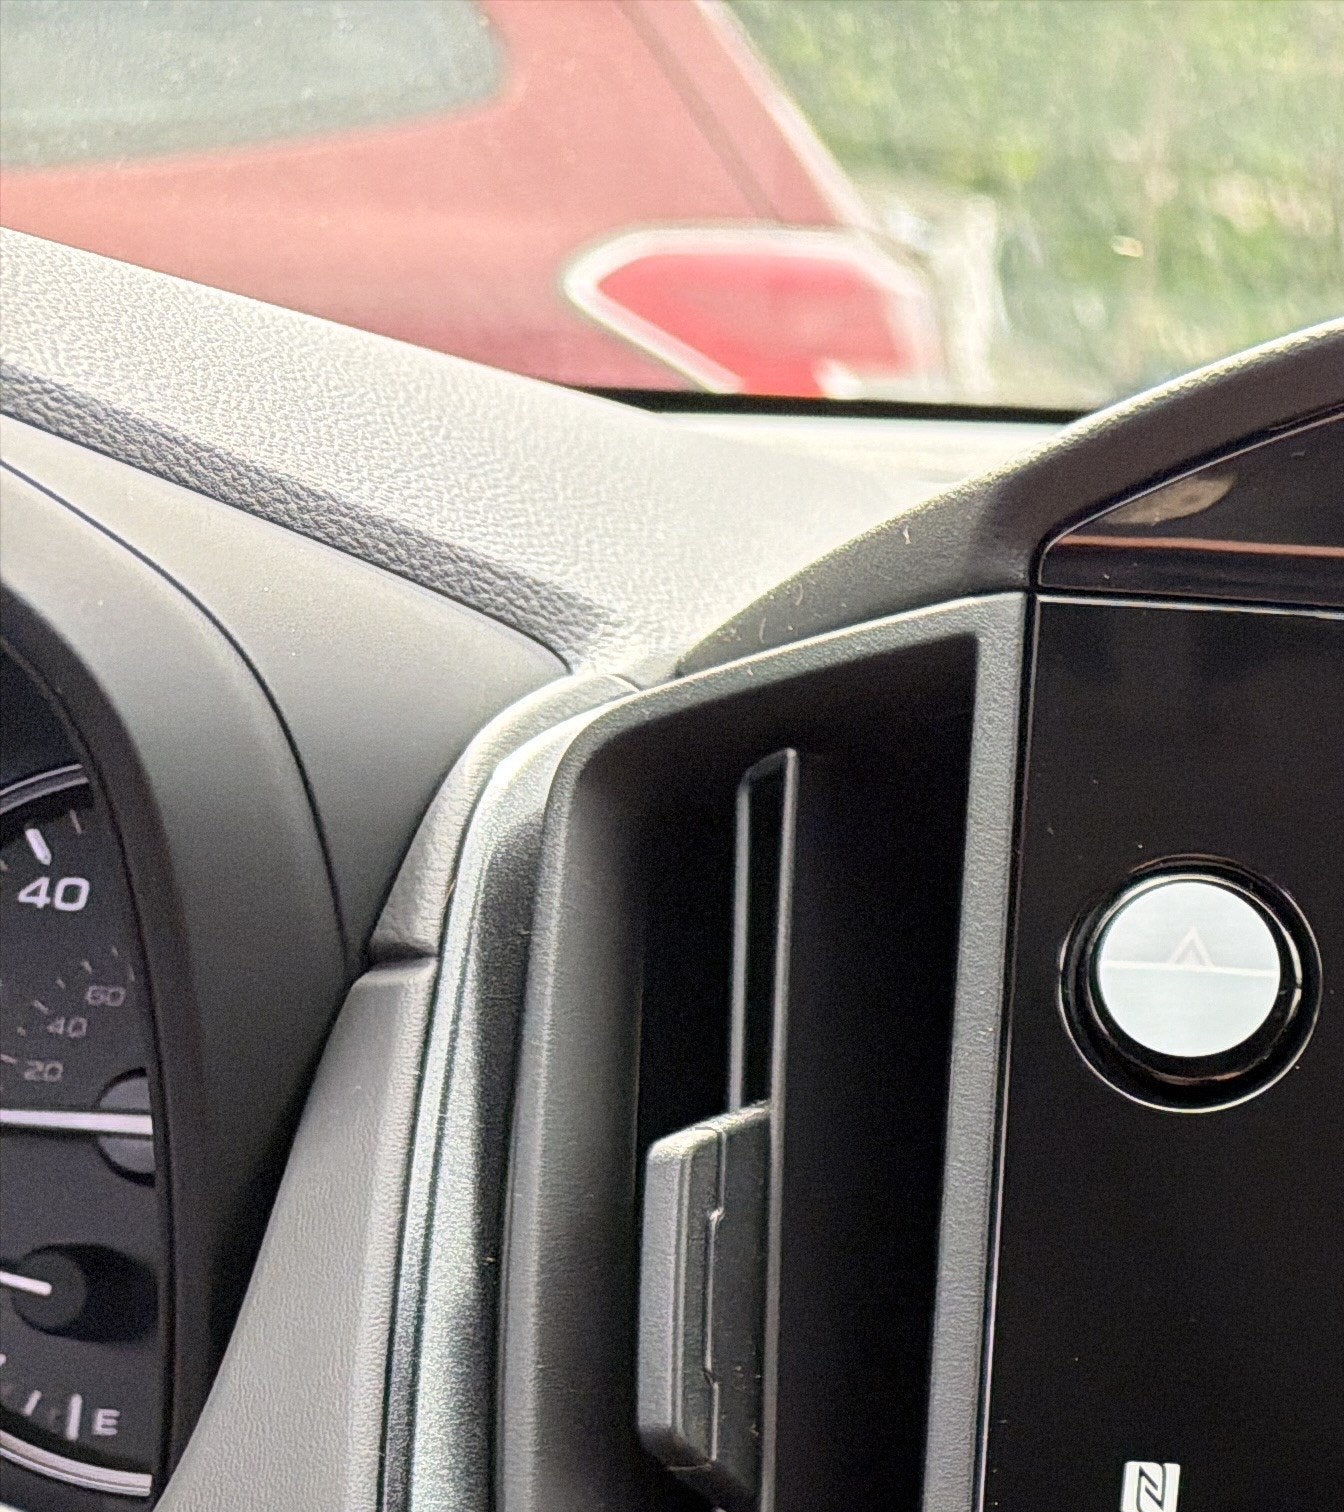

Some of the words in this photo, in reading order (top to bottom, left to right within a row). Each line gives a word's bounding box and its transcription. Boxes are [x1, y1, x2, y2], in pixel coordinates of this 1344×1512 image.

[18, 876, 90, 912] 40
[46, 1016, 88, 1039] 40
[23, 1060, 64, 1082] 20
[93, 1408, 120, 1436] E
